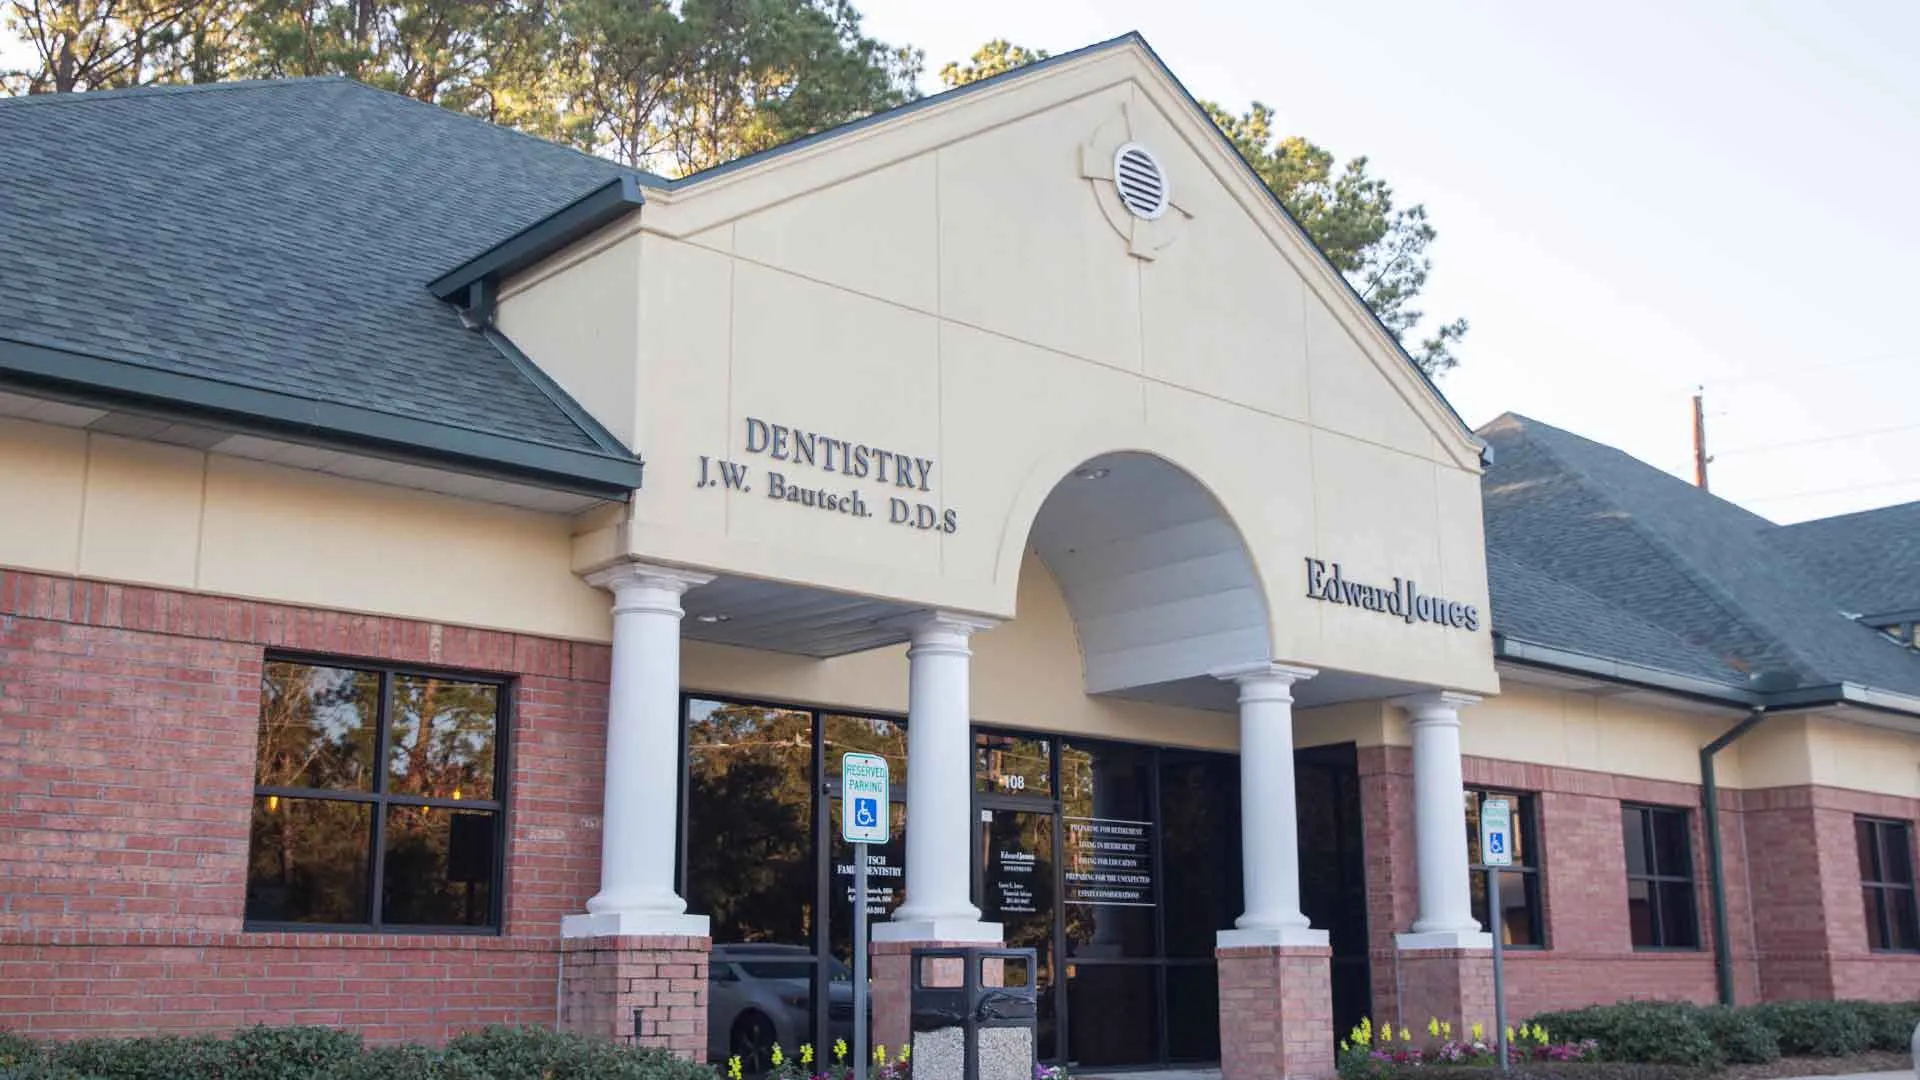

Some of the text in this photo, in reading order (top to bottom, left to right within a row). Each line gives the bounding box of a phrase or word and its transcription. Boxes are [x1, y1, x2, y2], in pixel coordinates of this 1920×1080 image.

[745, 417, 933, 491] DENTISTRY
[696, 456, 751, 493] J.W.
[847, 764, 885, 778] RESERVED
[848, 779, 883, 793] PARKING
[1004, 775, 1025, 790] 108
